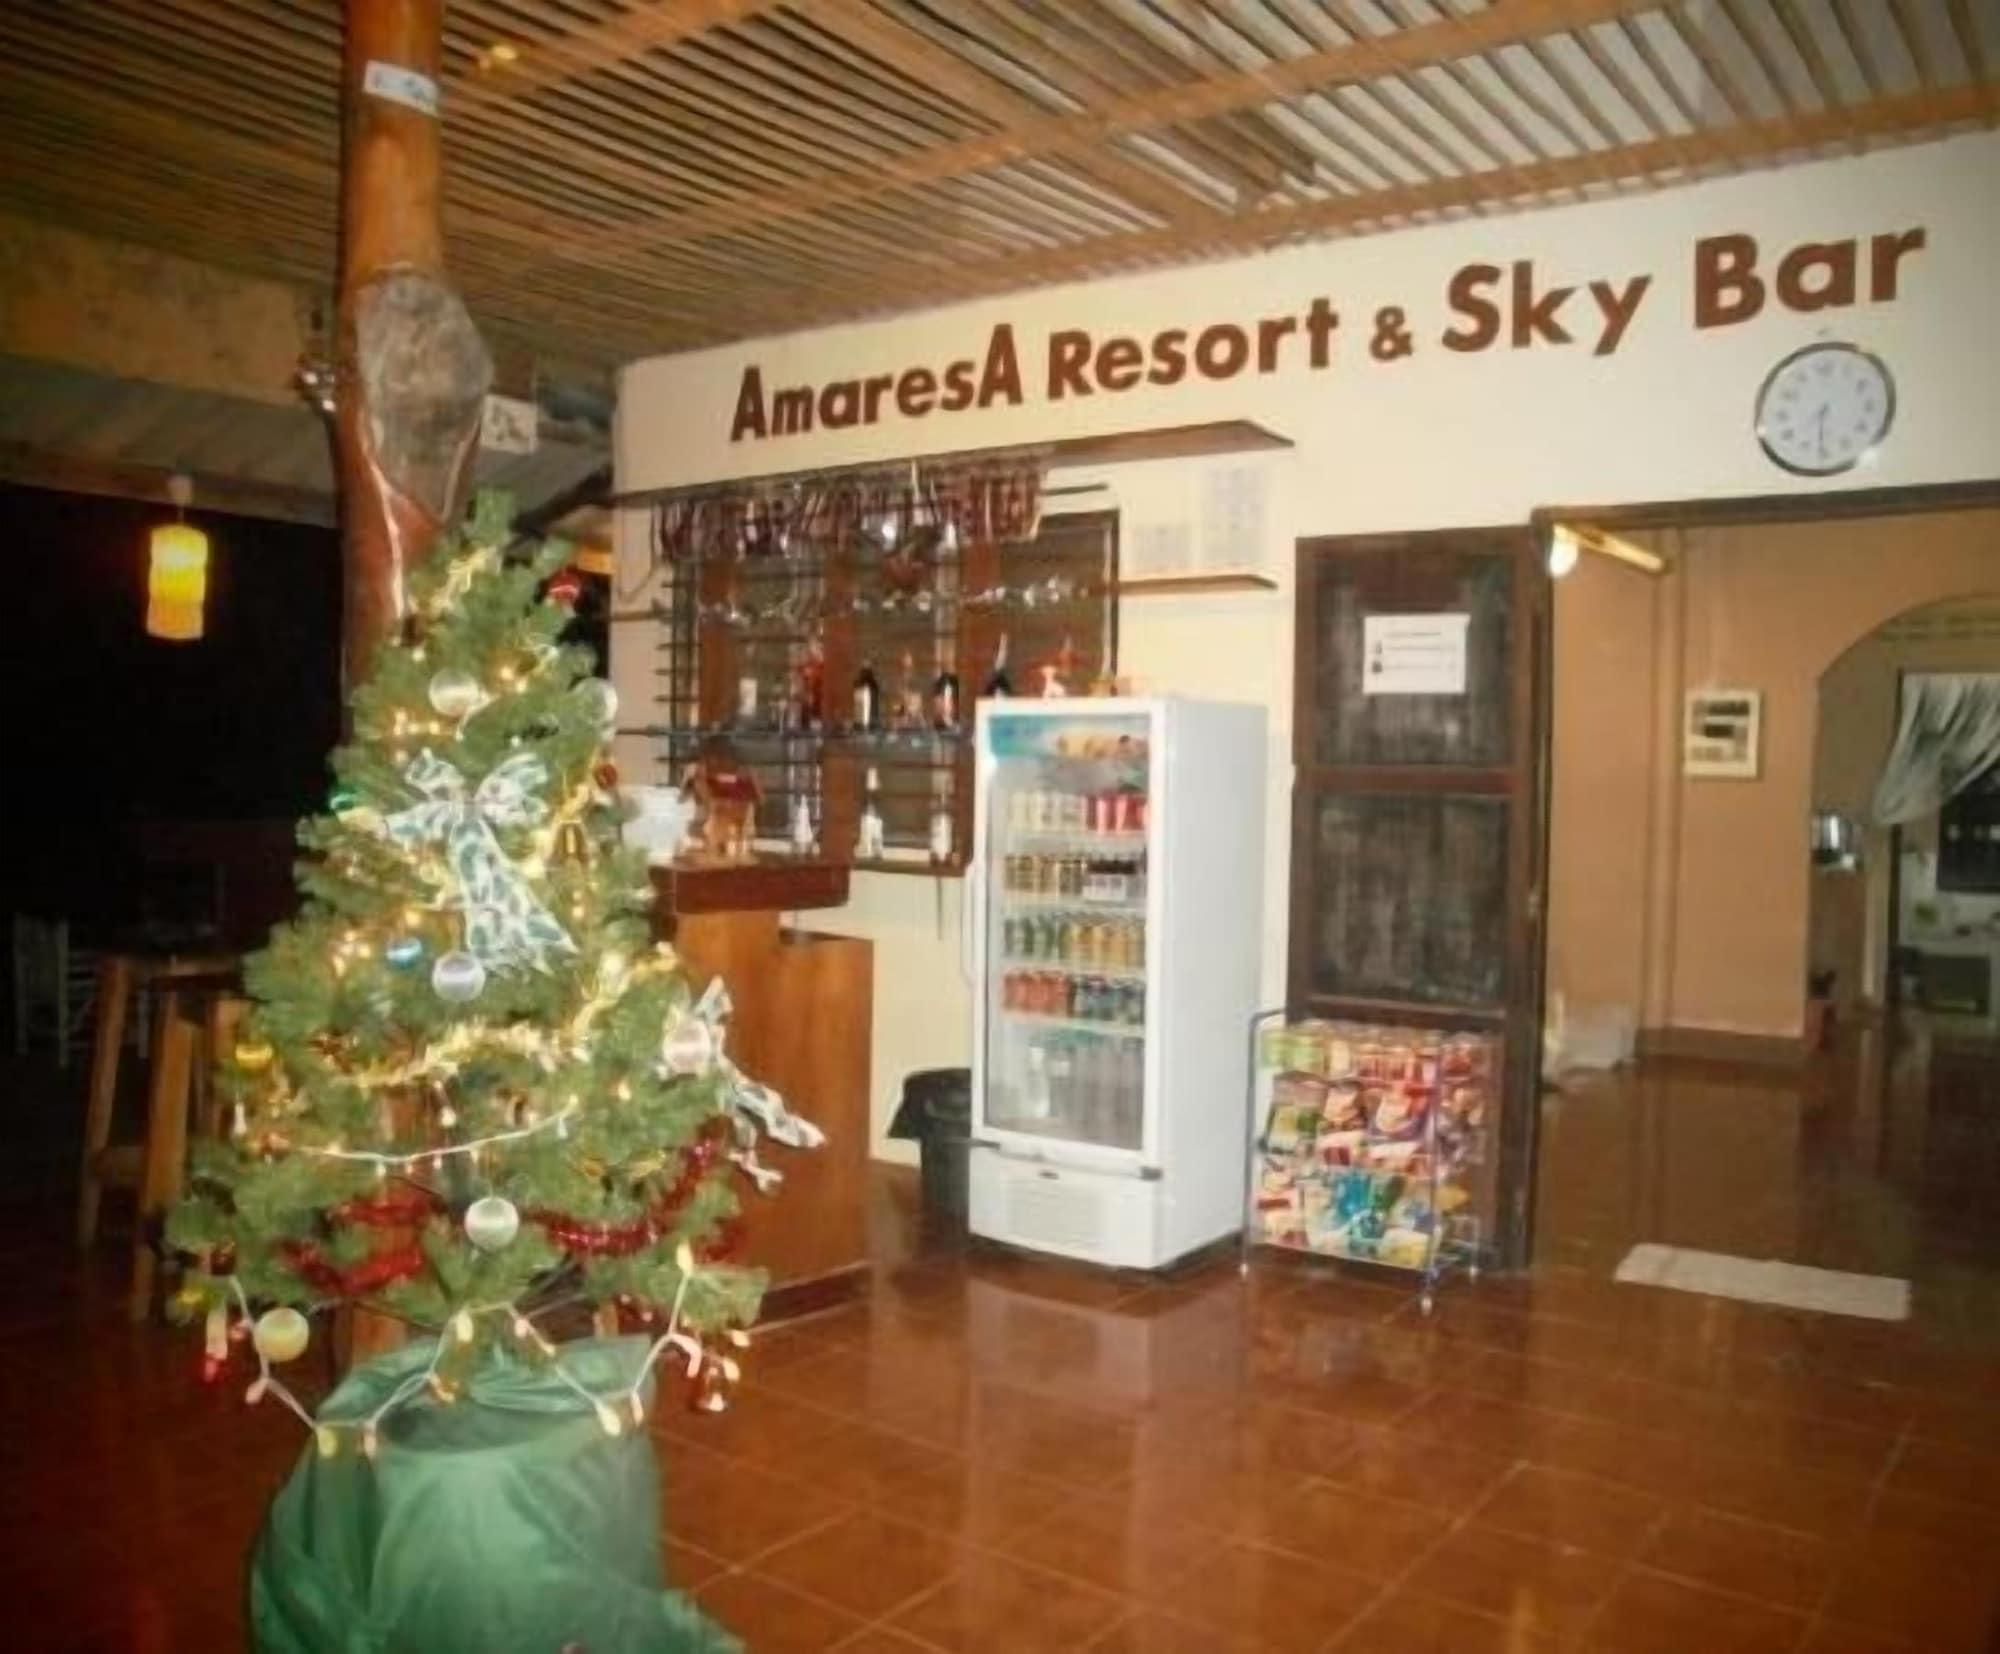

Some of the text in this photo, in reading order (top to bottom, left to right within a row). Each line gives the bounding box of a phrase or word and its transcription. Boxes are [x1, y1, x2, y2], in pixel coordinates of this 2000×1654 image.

[730, 226, 1925, 442] AmaresA Resort & Sky Bar
